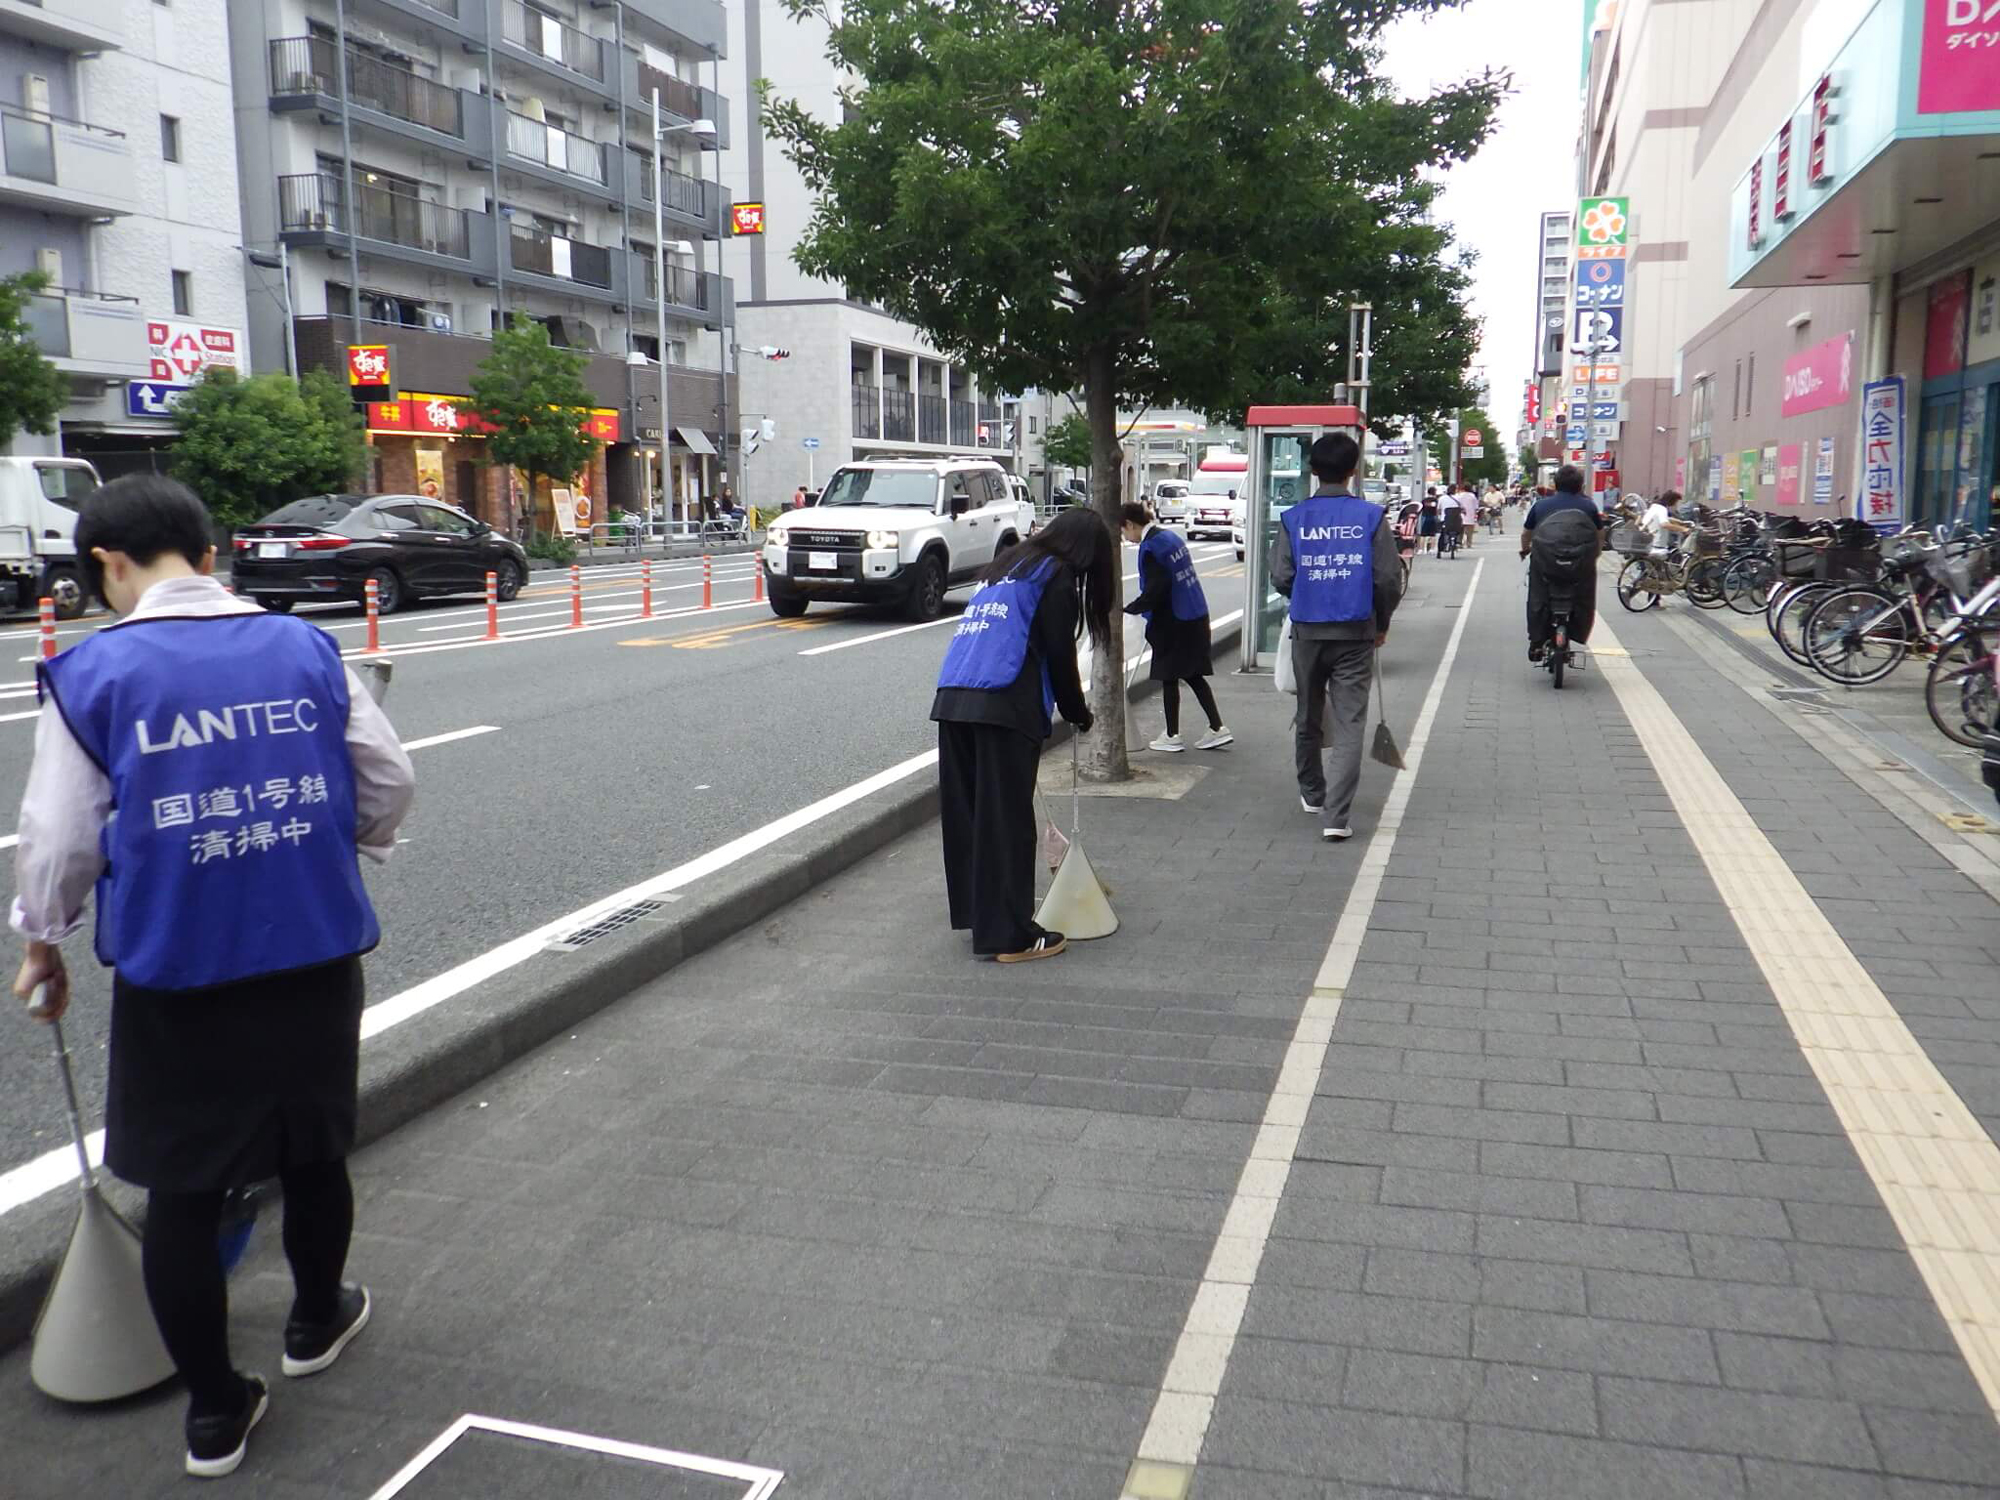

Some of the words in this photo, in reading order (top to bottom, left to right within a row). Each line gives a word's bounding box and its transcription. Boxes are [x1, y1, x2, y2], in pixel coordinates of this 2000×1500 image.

[353, 350, 385, 374] すき家
[426, 399, 458, 430] すき家
[810, 535, 840, 543] TOYOTA
[1300, 525, 1364, 540] LANTEC
[1301, 552, 1364, 567] 国道1号線
[1308, 567, 1351, 581] 清掃中
[135, 697, 319, 755] LANTEC
[152, 773, 329, 830] 国道1号線
[190, 816, 313, 864] 清掃中
